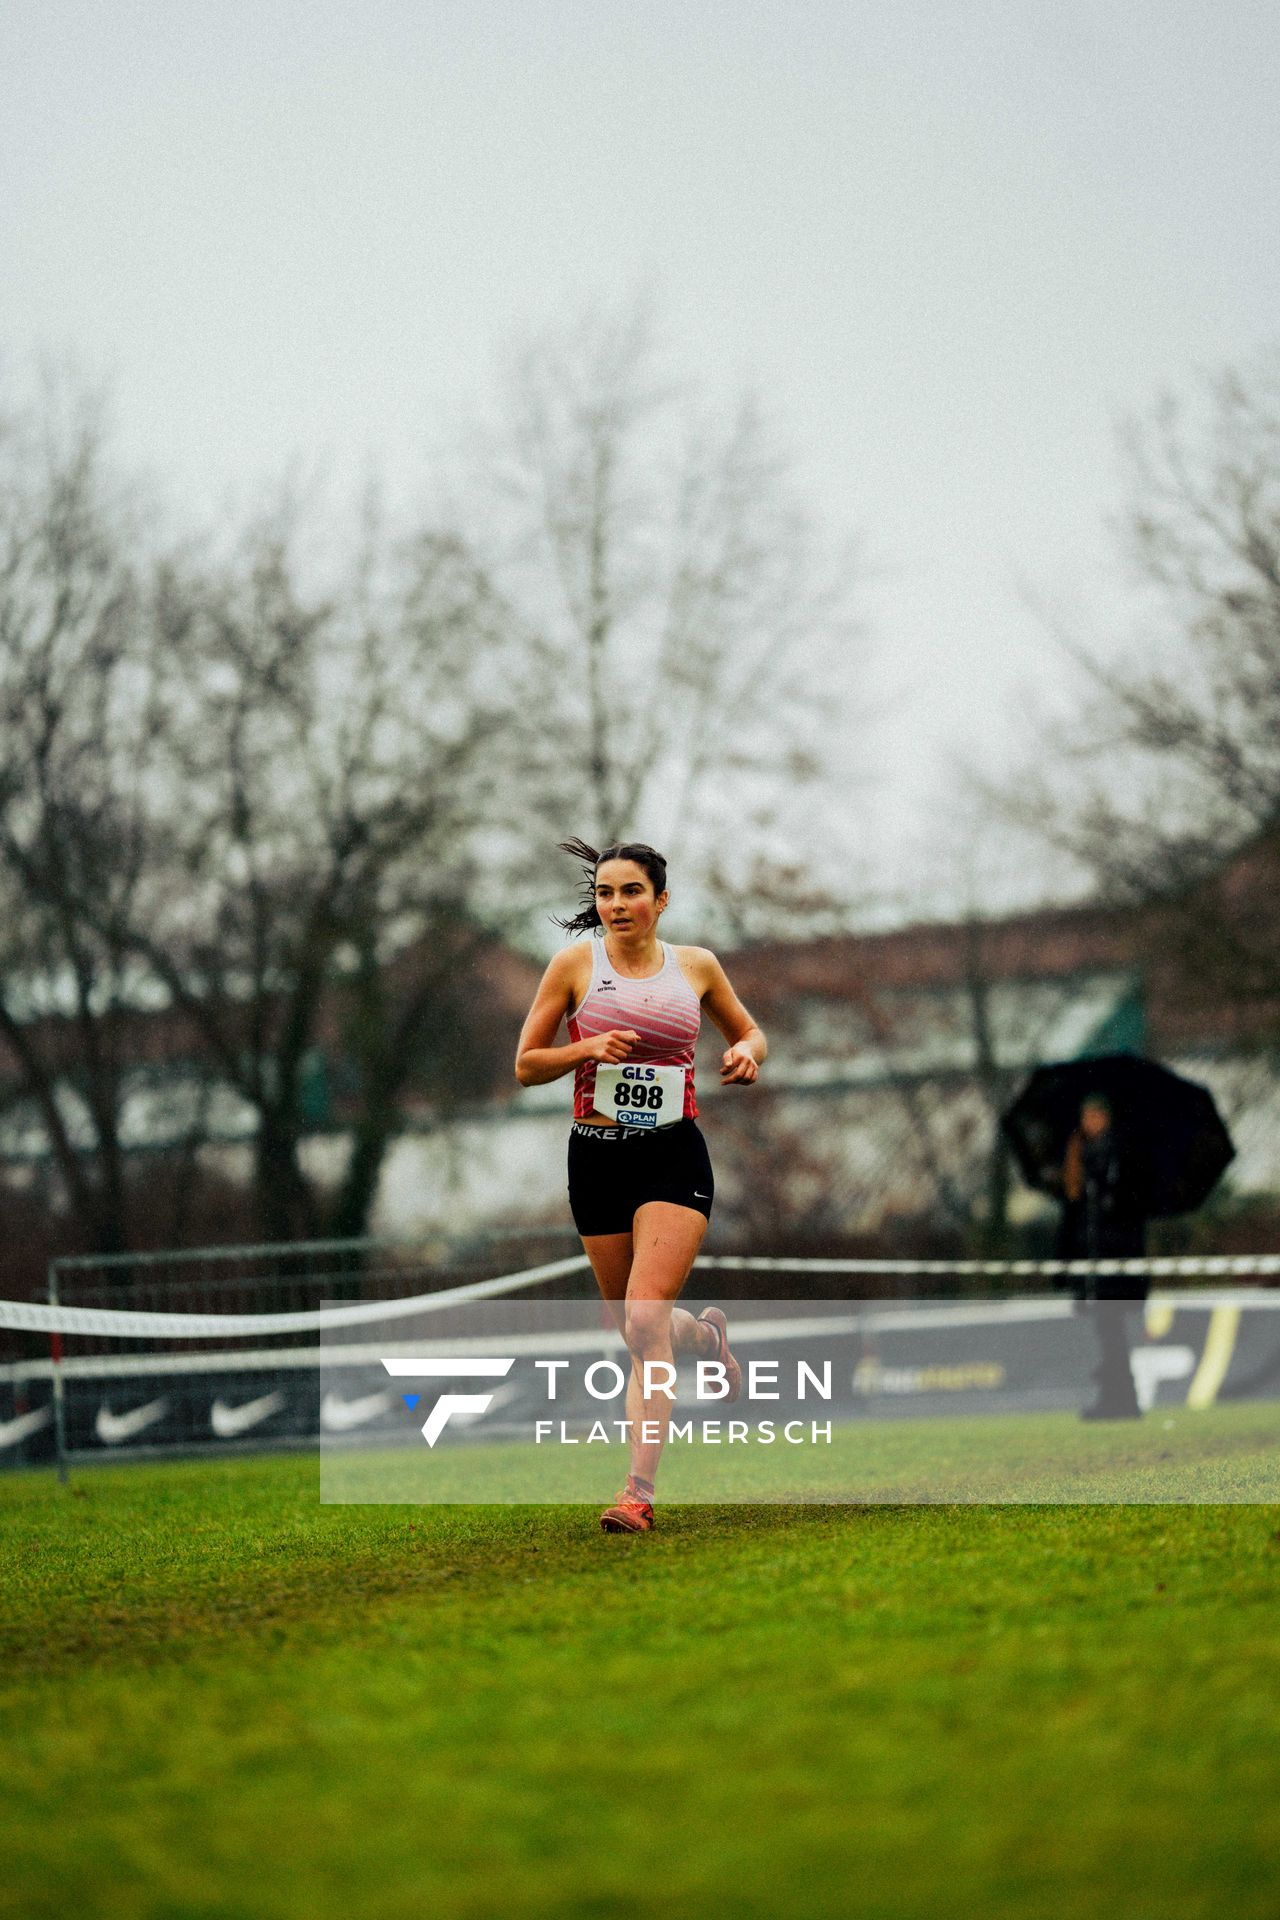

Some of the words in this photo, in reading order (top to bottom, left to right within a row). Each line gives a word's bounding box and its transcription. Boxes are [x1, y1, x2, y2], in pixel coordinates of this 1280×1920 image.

[614, 1083, 663, 1109] 898
[633, 1114, 655, 1122] PLAN
[573, 1123, 619, 1140] NIKE
